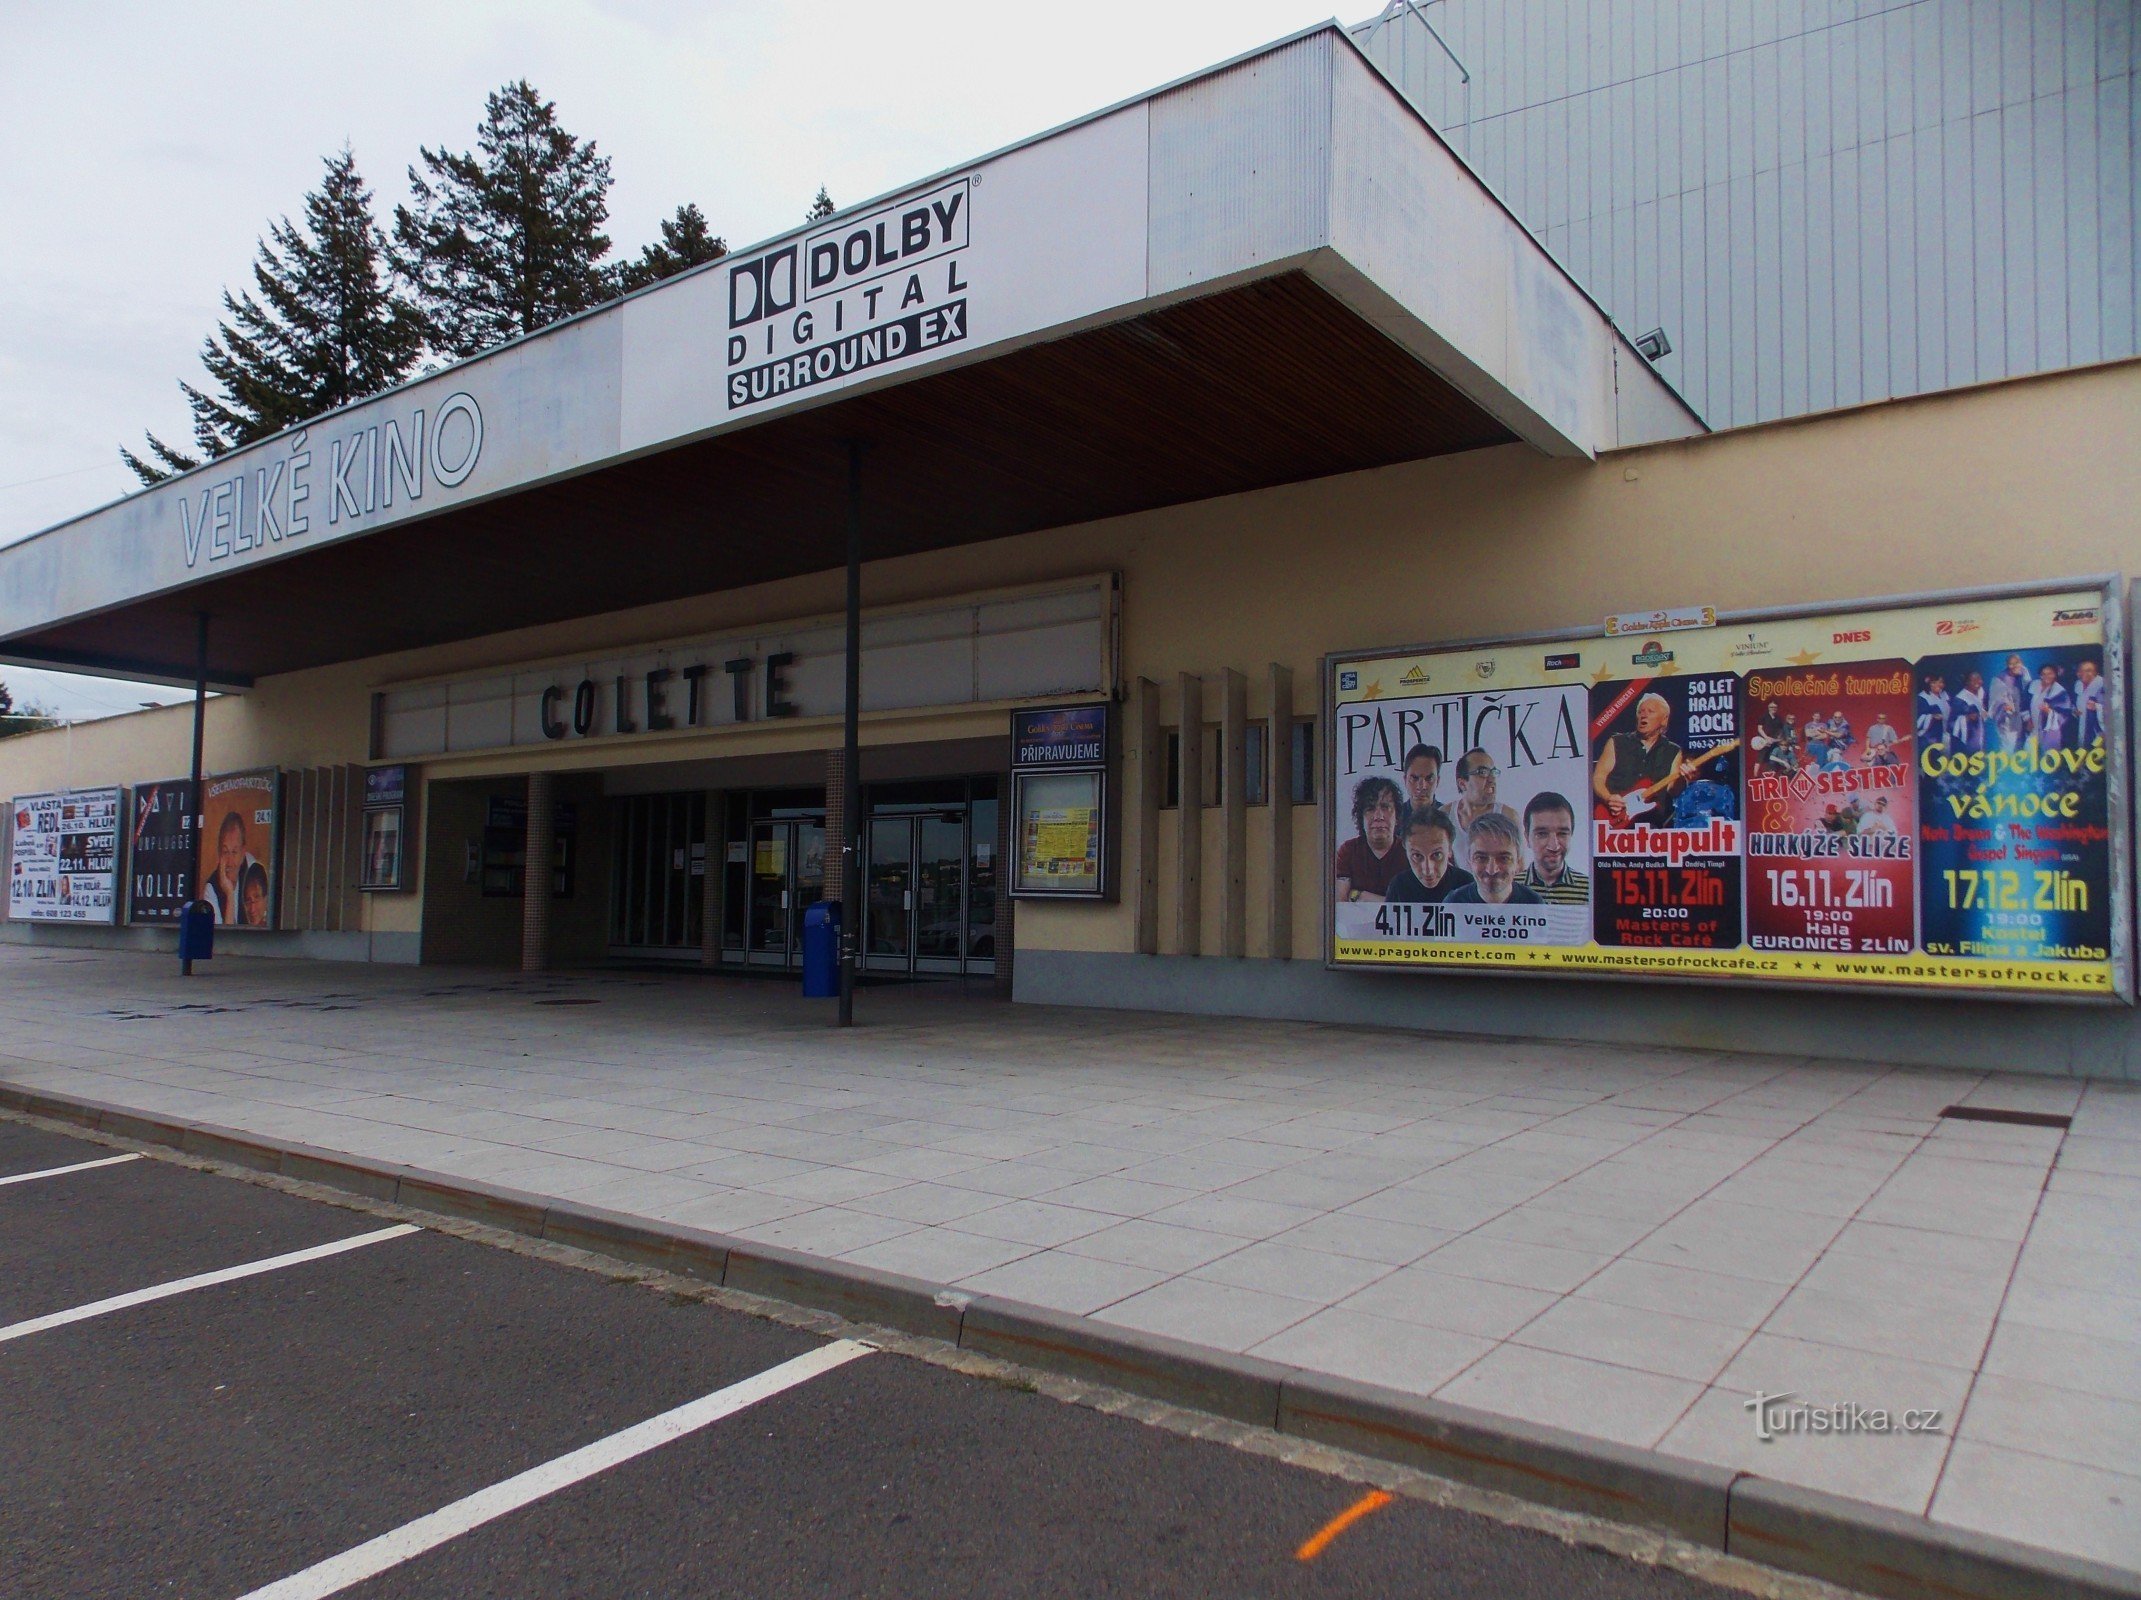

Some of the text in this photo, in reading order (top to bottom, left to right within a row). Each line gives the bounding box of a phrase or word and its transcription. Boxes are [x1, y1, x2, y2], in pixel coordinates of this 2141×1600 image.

[811, 192, 964, 289] DOLBY
[728, 260, 967, 367] DIGITAL
[731, 304, 962, 405] SURROUND EX
[179, 392, 483, 568] VELKÉ KINO
[1832, 630, 1871, 644] DNES
[541, 652, 793, 740] COLETTE
[1688, 679, 1734, 695] 50 LET
[1748, 671, 1910, 701] Společné turné!
[1688, 695, 1733, 712] HRAJU
[1688, 712, 1734, 734] ROCK
[1340, 694, 1584, 775] PARTIČKA
[1020, 743, 1100, 762] PŘIPRAVUJEME
[1920, 736, 2106, 786] Gospelové
[1748, 763, 1908, 801] TŘI SESTRY
[30, 799, 62, 811] VLASTA
[1947, 784, 2081, 819] vánoce
[37, 812, 60, 833] REDL
[88, 816, 115, 829] HLUK
[1762, 798, 1794, 833] &
[86, 834, 115, 849] SWEET
[138, 833, 190, 851] UNPLUGGE
[1597, 820, 1736, 864] katapult
[1750, 829, 1911, 860] HORKÝŽE SLÍŽE
[60, 858, 86, 871] 22.11.
[88, 857, 113, 871] HLUK
[136, 873, 185, 898] KOLLE
[1611, 870, 1724, 906] 15.11. Zlín
[1766, 869, 1893, 908] 16.11. Zlín
[1943, 869, 2088, 911] 17.12. Zlín
[1375, 905, 1456, 937] 4.11. Zlín
[1464, 914, 1506, 926] Velké
[1512, 914, 1547, 927] Kino
[1642, 908, 1688, 918] 20:00
[1803, 910, 1853, 921] 19:00
[1481, 928, 1529, 939] 20:00
[1616, 918, 1719, 932] Masters of
[1806, 922, 1850, 936] Hala
[1620, 932, 1663, 946] Rock
[1751, 935, 1909, 952] EURONICS ZLÍN
[1927, 941, 1954, 954] sv.
[2034, 943, 2107, 960] Jakuba
[1340, 945, 2107, 984] www.pragokoncert.com www.mastersofrockcafe.cz www.mastersofrock.cz
